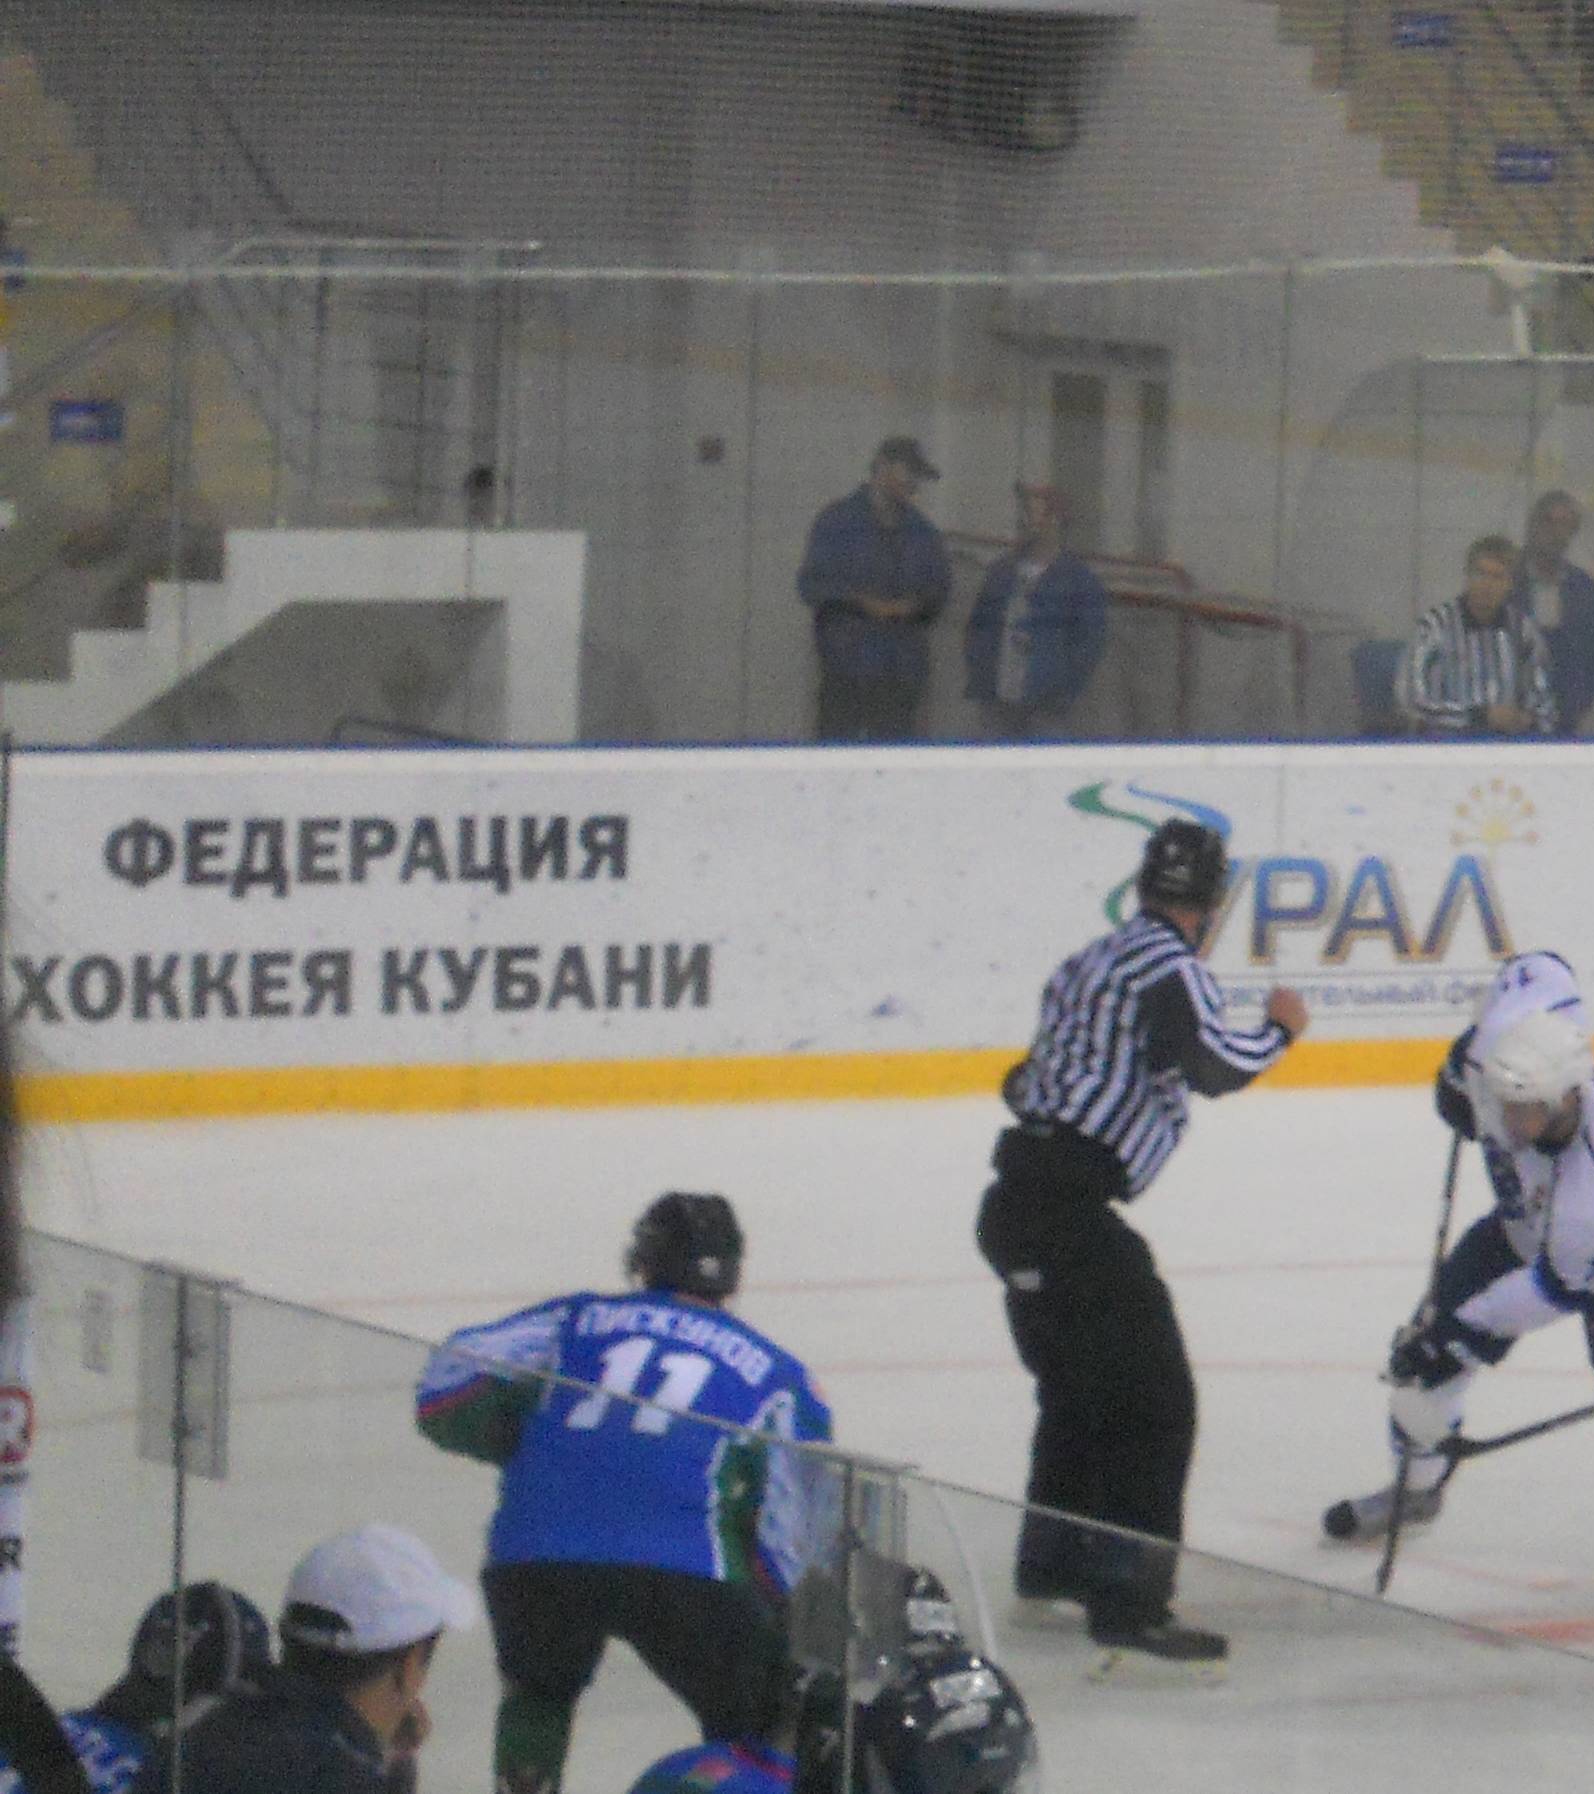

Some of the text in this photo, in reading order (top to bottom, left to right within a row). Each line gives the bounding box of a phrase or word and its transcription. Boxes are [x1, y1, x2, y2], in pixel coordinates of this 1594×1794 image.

[103, 814, 630, 899] ФЕДЕРАЦИЯ
[10, 942, 714, 1023] ХОККЕЯ КУБАНИ
[565, 1335, 716, 1437] 11
